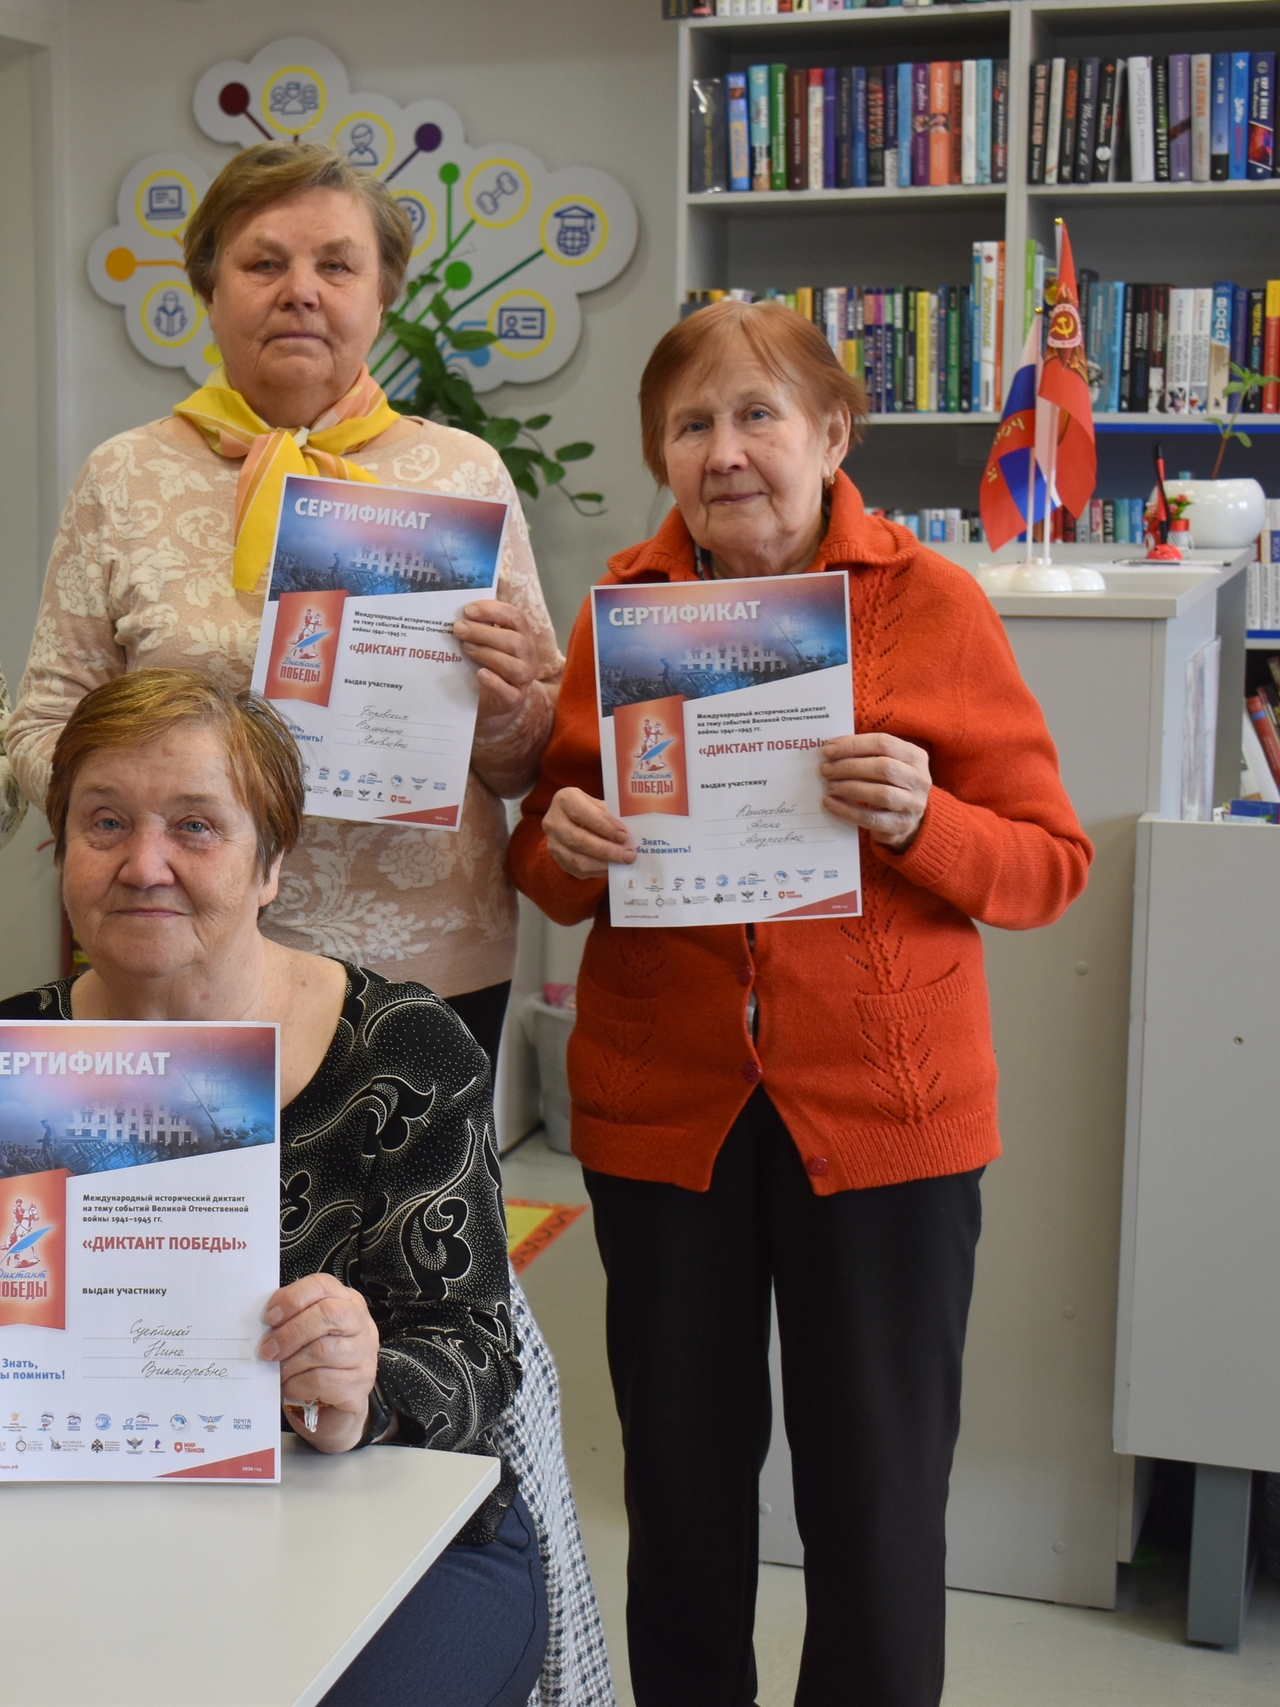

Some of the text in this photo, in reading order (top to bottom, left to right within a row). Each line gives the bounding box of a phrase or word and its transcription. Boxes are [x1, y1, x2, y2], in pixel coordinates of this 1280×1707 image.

[294, 496, 431, 531] СЕРТИФИКАТ
[607, 600, 761, 628] СЕРТИФИКАТ
[426, 626, 454, 635] Отечестве
[280, 666, 320, 684] ПОБЕДЫ
[344, 678, 403, 691] выдан участнику
[630, 770, 672, 780] Диктант
[630, 780, 674, 796] ПОБЕДЫ
[728, 779, 767, 788] участнику
[641, 838, 670, 848] Знать,
[650, 845, 691, 855] помнить!
[83, 1194, 152, 1203] Международный
[155, 1194, 210, 1203] исторический
[82, 1236, 247, 1252] «ДИКТАНТ ПОБЕДЫ»
[82, 1287, 167, 1297] выдан участнику
[144, 1339, 184, 1358] Нине
[2, 1358, 38, 1370] Знать,
[13, 1370, 65, 1380] помнить!
[141, 1360, 228, 1383] Викторовне
